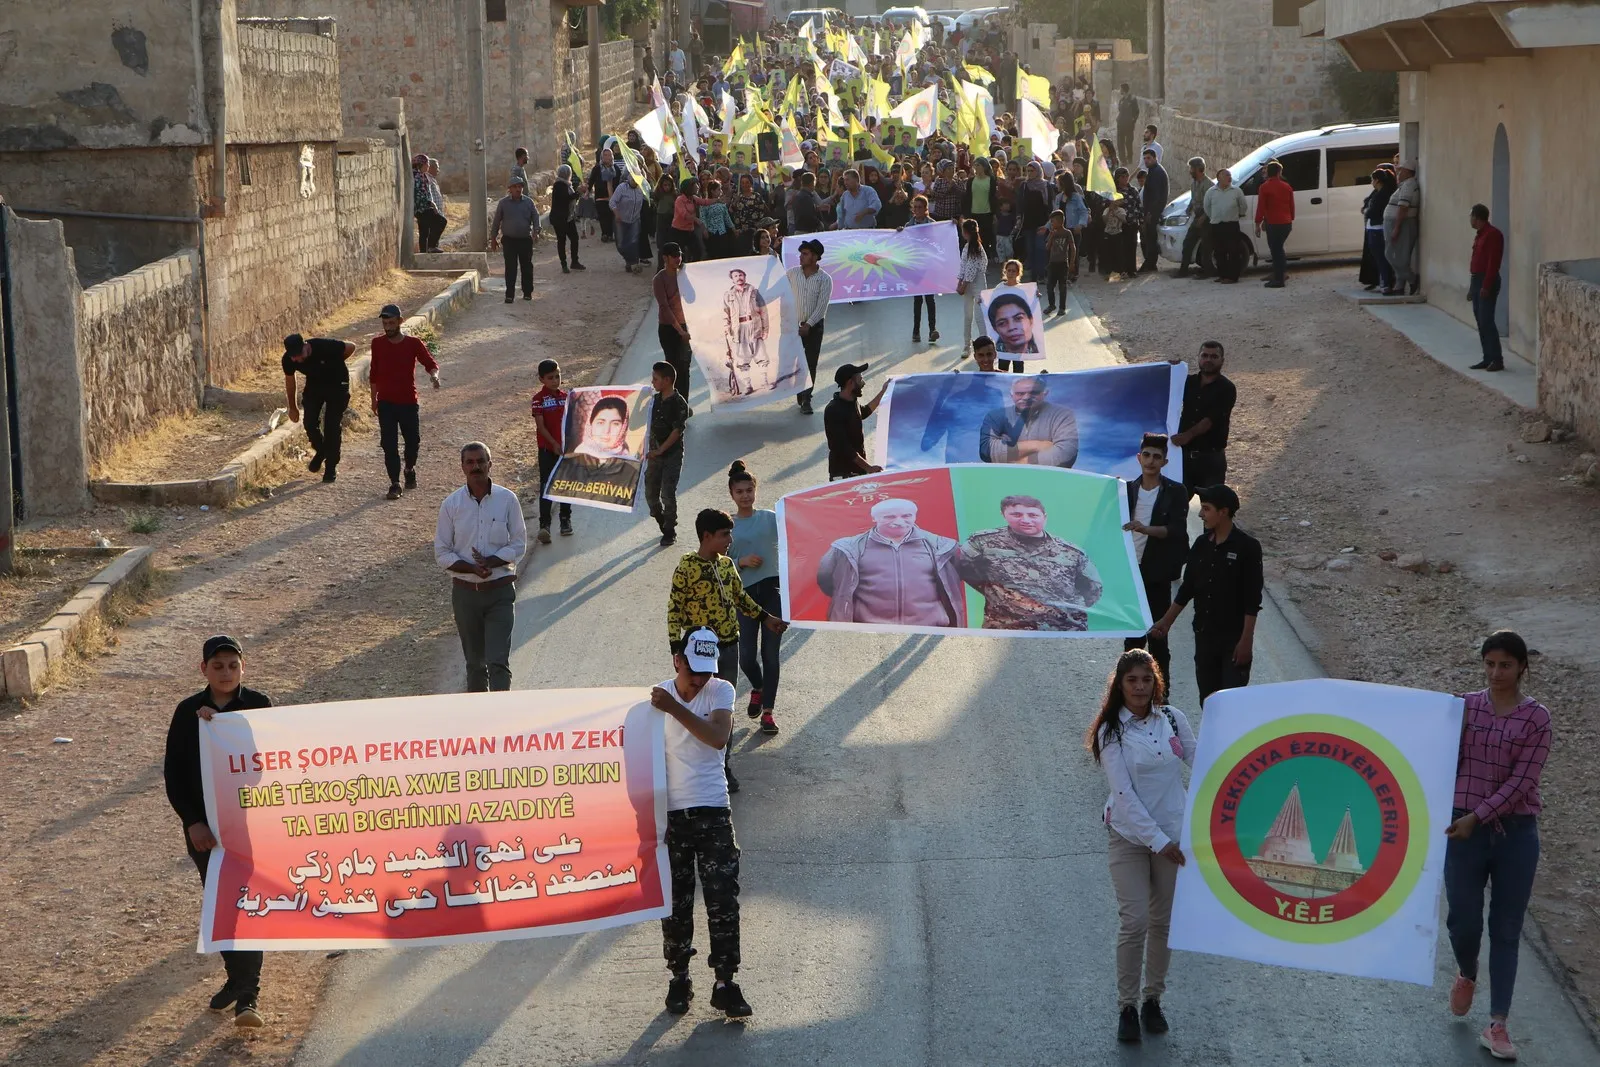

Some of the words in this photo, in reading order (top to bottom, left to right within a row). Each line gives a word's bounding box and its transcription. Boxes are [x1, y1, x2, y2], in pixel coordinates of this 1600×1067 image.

[228, 753, 247, 774] LI
[251, 751, 293, 773] SER
[297, 745, 358, 774] ŞOPA
[364, 736, 496, 763] PEKREWAN
[503, 731, 565, 753] MAM
[571, 725, 626, 750] ZEKÎ
[238, 781, 285, 808] EMÊ
[286, 774, 402, 806] TÊKOŞÎNA
[405, 770, 460, 795] XWE
[465, 765, 549, 792] BILIND
[553, 761, 621, 786] BIKIN
[282, 815, 312, 837] TA
[314, 811, 349, 836] EM
[353, 802, 462, 833] BIGHÎNIN
[466, 792, 575, 824] AZADIYÊ
[337, 848, 377, 885] مام
[384, 840, 469, 878] الشهيد
[473, 836, 527, 872] نهج
[533, 833, 583, 864] على
[288, 850, 333, 889] زكي
[236, 886, 309, 917] الحرية
[311, 887, 380, 918] تحقيق
[385, 886, 438, 918] حتى
[443, 871, 539, 908] نضالنا
[1274, 896, 1335, 922] Y.Ê.E
